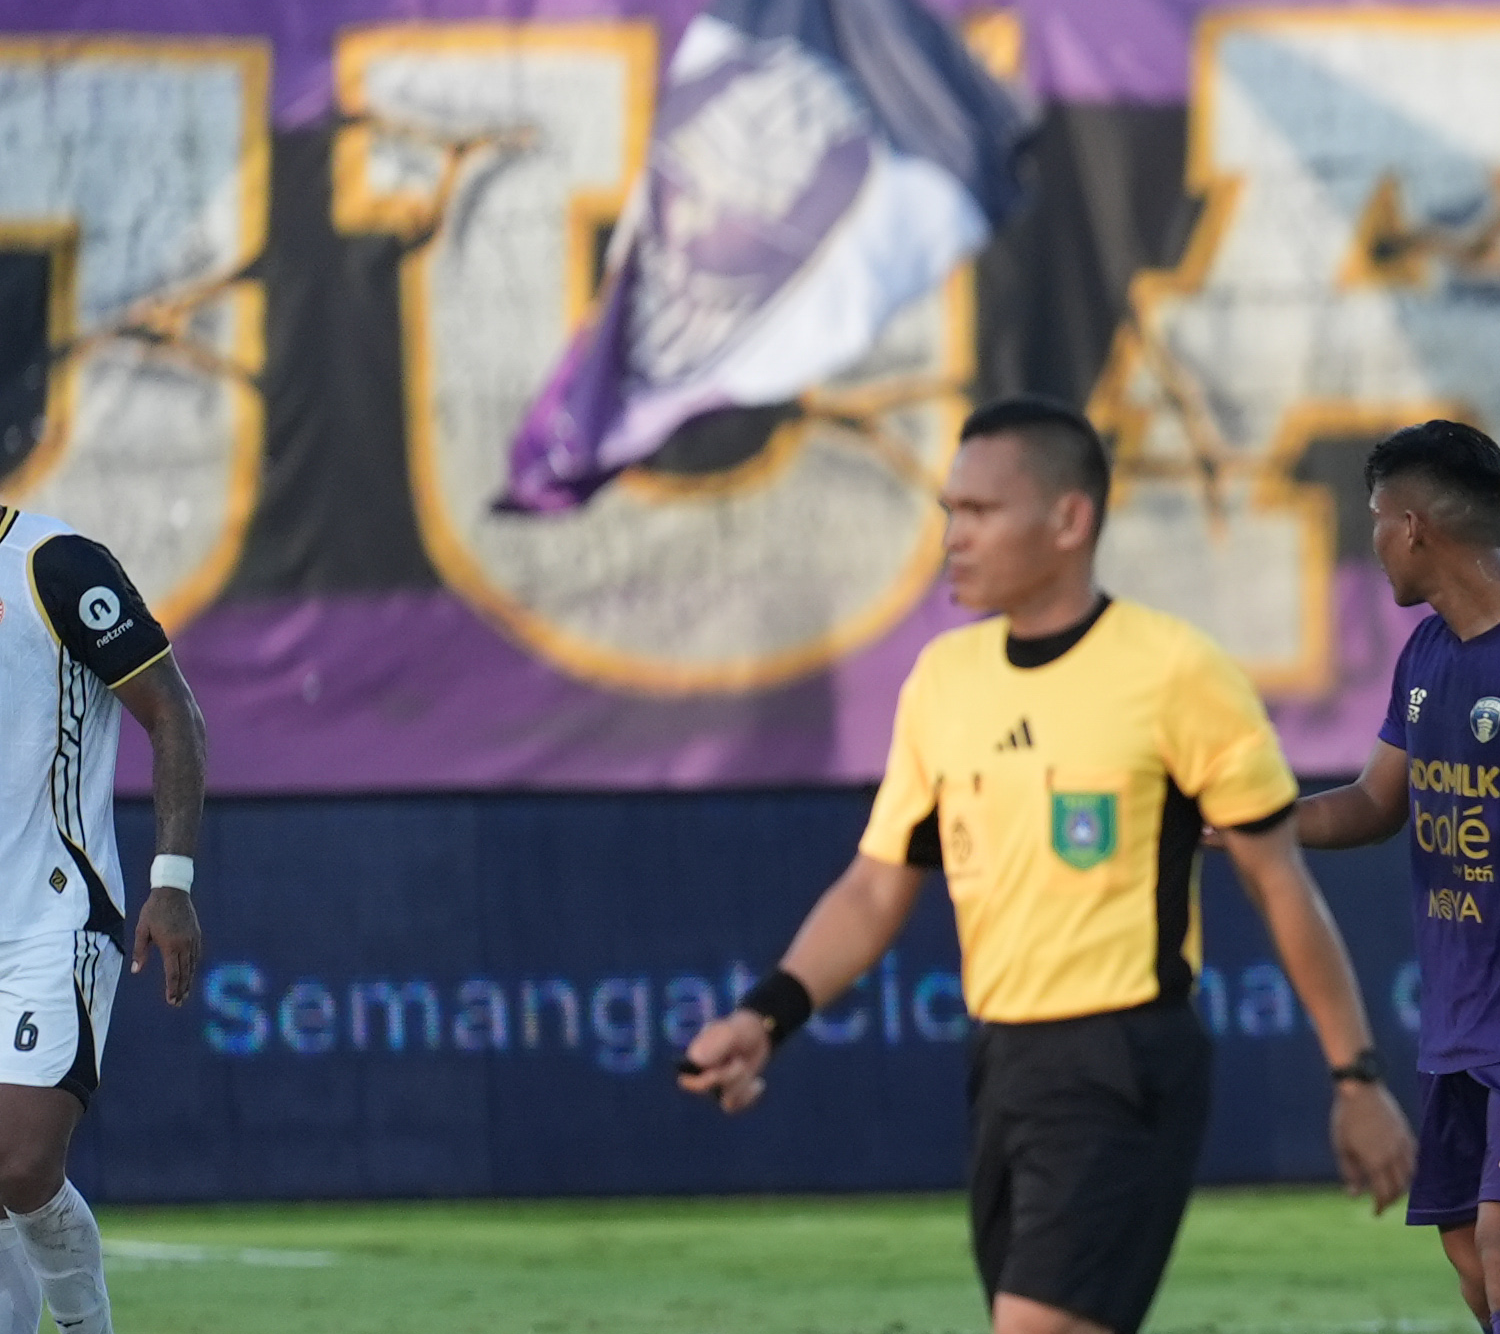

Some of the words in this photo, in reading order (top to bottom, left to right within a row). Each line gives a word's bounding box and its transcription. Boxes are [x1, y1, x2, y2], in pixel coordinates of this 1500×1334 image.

[96, 618, 134, 649] netzme
[1410, 757, 1500, 799] DOMILK
[1414, 800, 1491, 860] balé
[13, 1010, 39, 1052] 6
